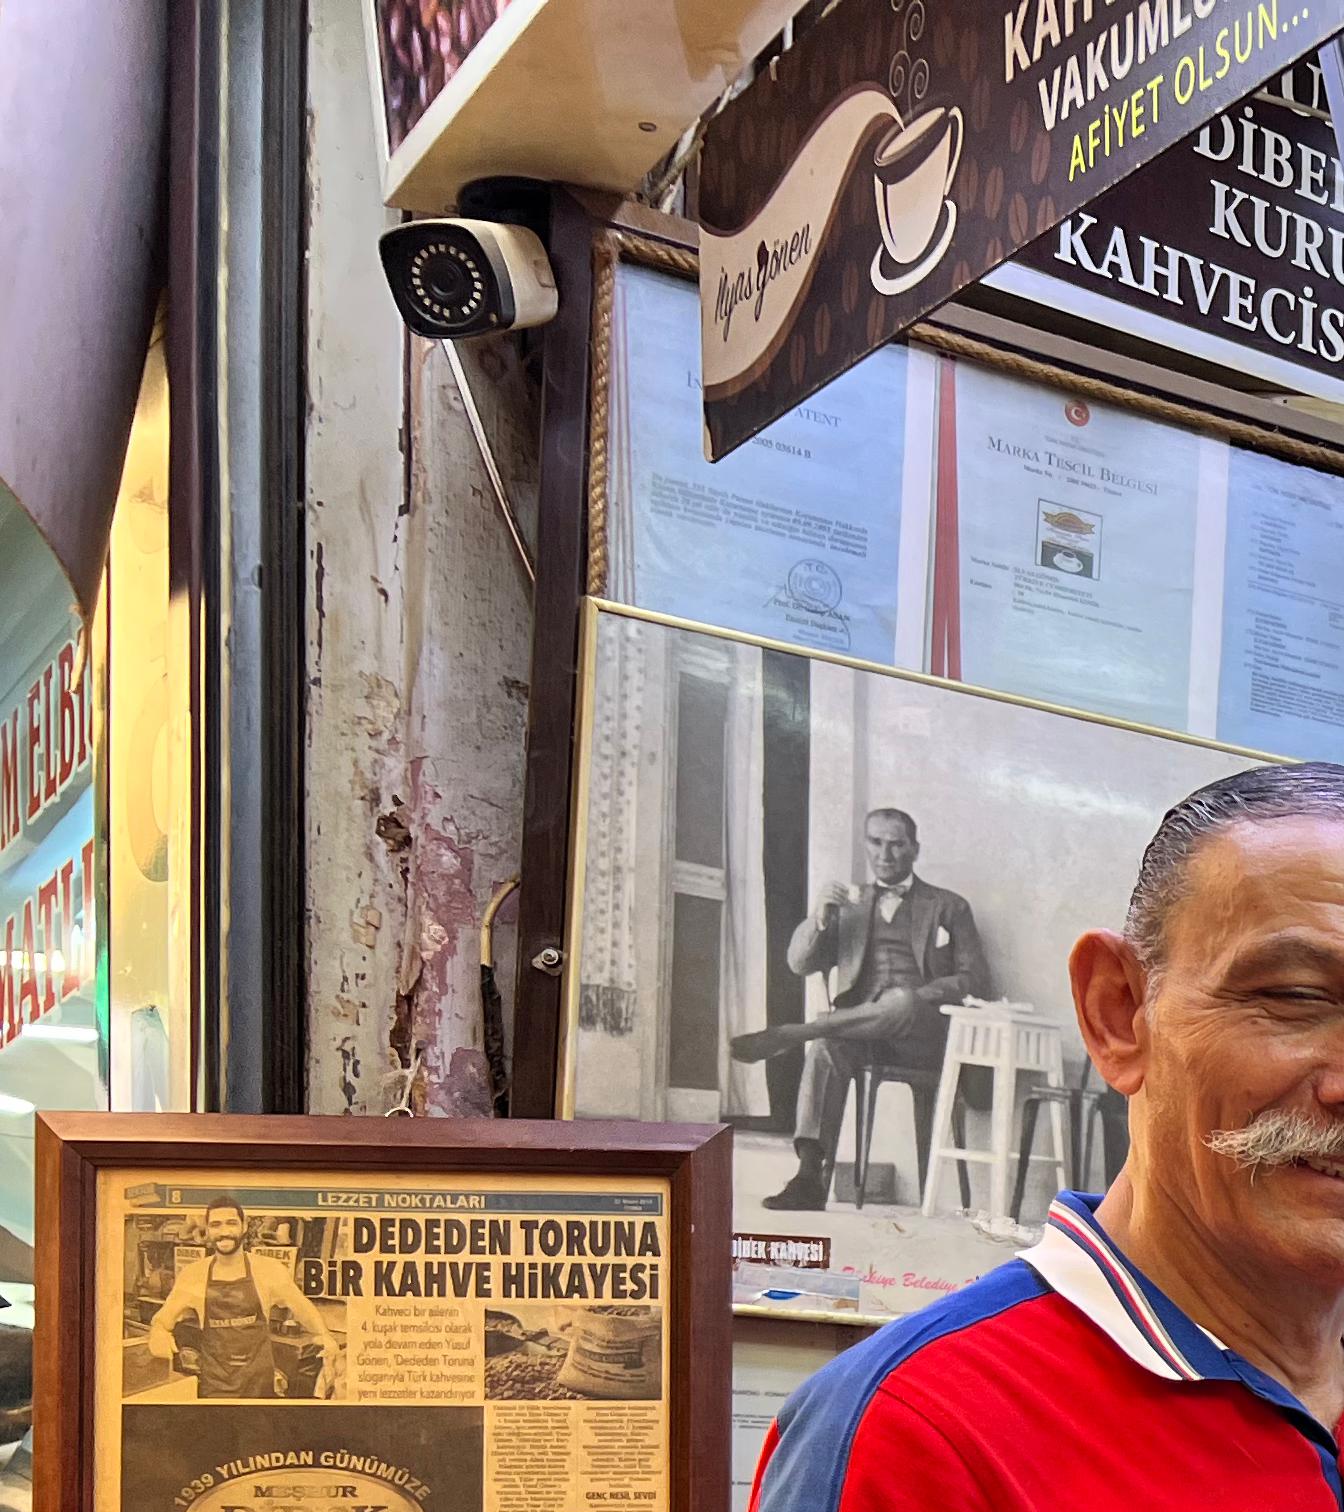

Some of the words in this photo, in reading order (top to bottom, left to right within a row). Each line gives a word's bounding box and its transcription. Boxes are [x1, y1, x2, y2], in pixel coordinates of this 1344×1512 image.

[1003, 0, 1115, 84] KAH
[1069, 75, 1164, 181] AFİYET
[794, 407, 841, 428] ATENT
[987, 436, 1040, 463] MARKA
[171, 1191, 181, 1204] 8
[317, 1193, 382, 1207] LEZZET
[384, 1193, 486, 1209] NOKTALARI
[353, 1218, 511, 1255] DEDEDEN
[520, 1219, 662, 1257] TORUNA
[374, 1261, 492, 1298] KAHVE
[407, 1371, 428, 1383] Türk
[174, 1473, 214, 1507] 1939
[215, 1450, 314, 1479] YILINDAN
[319, 1449, 431, 1501] GÜNÜMÜZE
